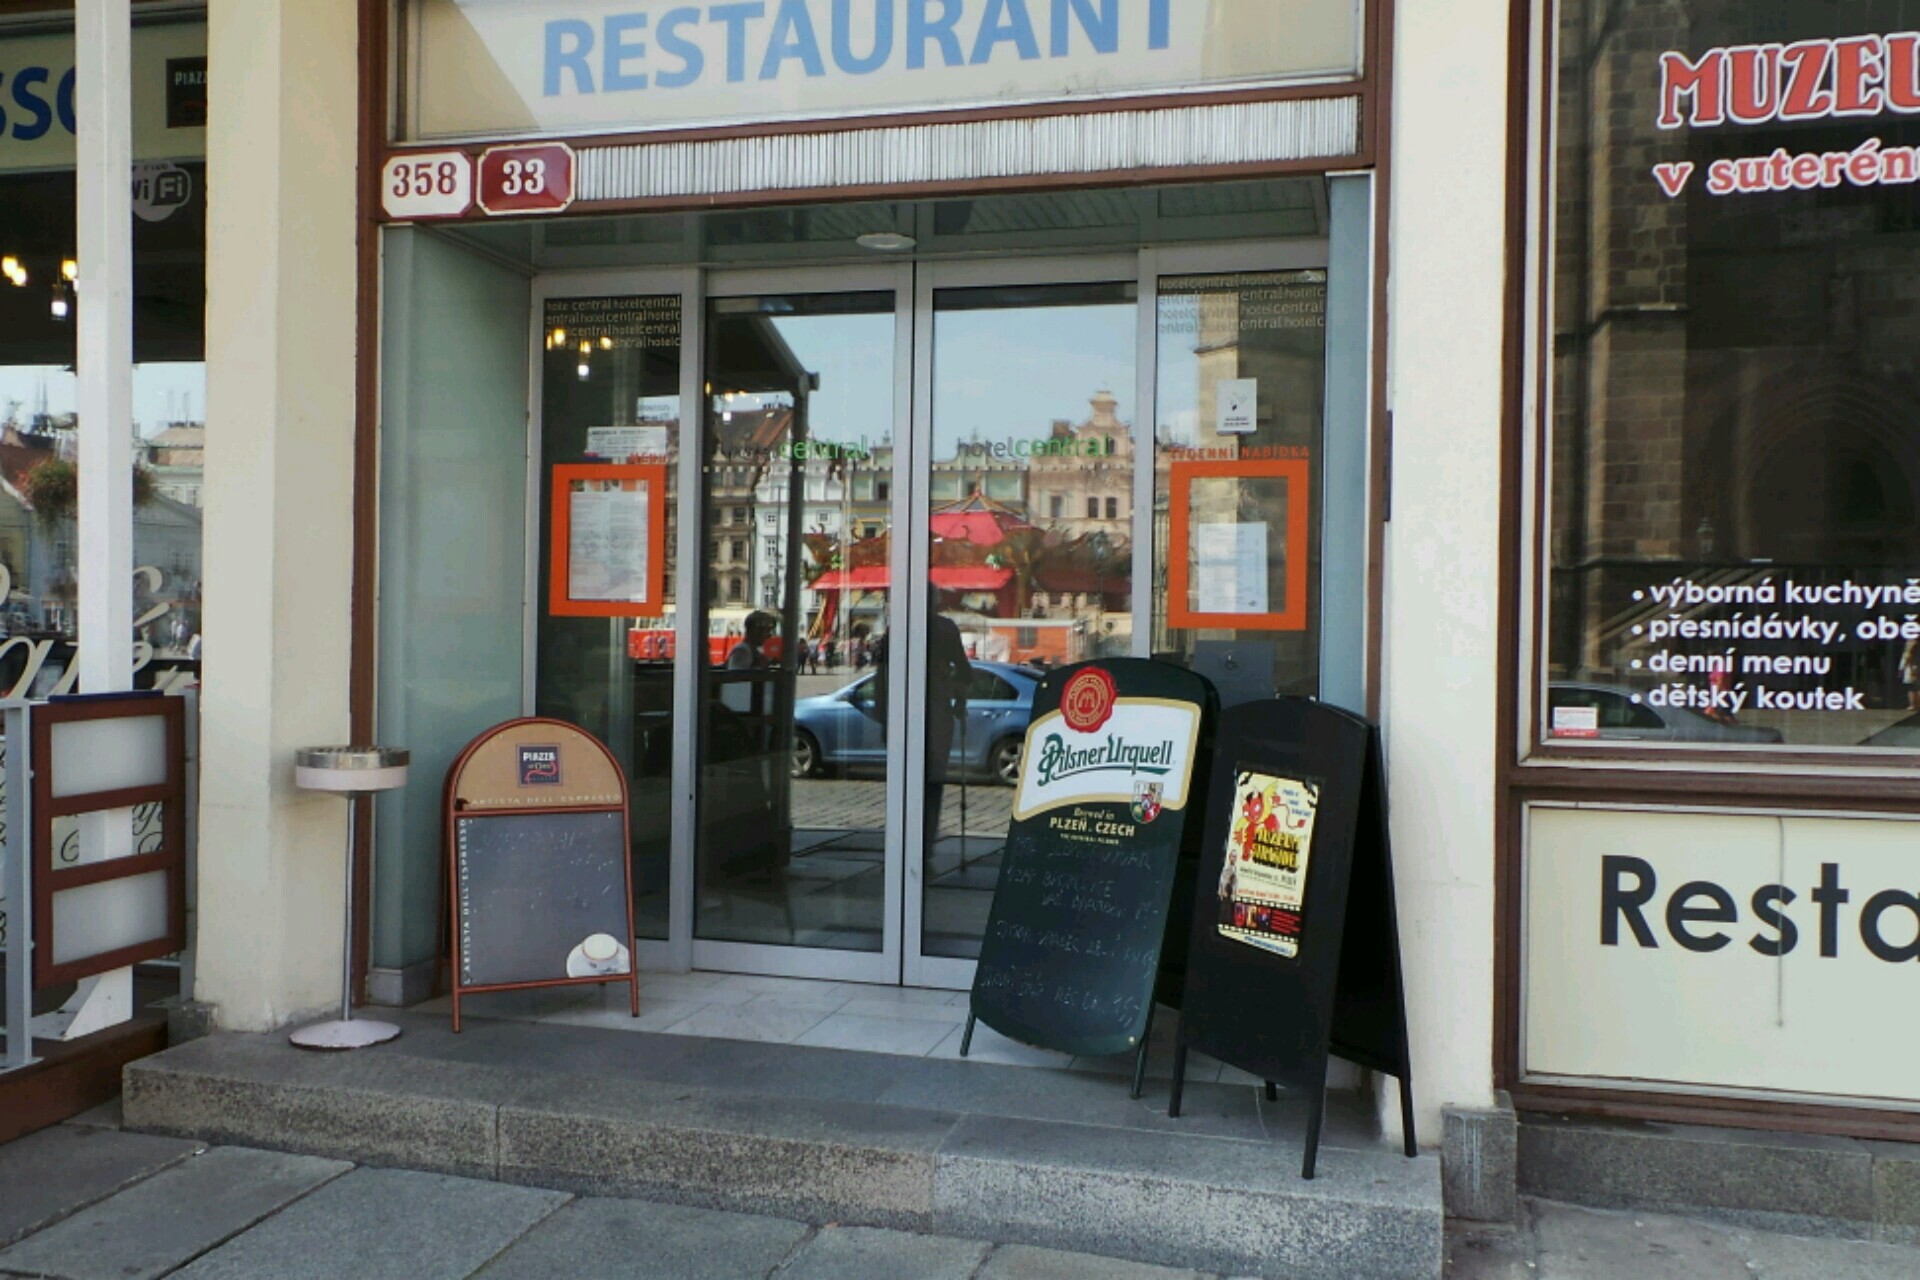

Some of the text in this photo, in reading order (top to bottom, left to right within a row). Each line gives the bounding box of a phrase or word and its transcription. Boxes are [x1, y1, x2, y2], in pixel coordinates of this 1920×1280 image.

[392, 162, 457, 198] 358
[501, 158, 546, 195] 33
[1653, 138, 1920, 198] v suterén
[1649, 576, 1920, 609] výborná kuchyně
[1649, 611, 1847, 643] přesnídávky,
[1648, 647, 1831, 674] denní menu
[1648, 682, 1865, 713] dětský koutek
[1037, 732, 1174, 786] Pilsner Urquell
[1095, 821, 1136, 837] CZECH
[1600, 853, 1920, 963] Resta
